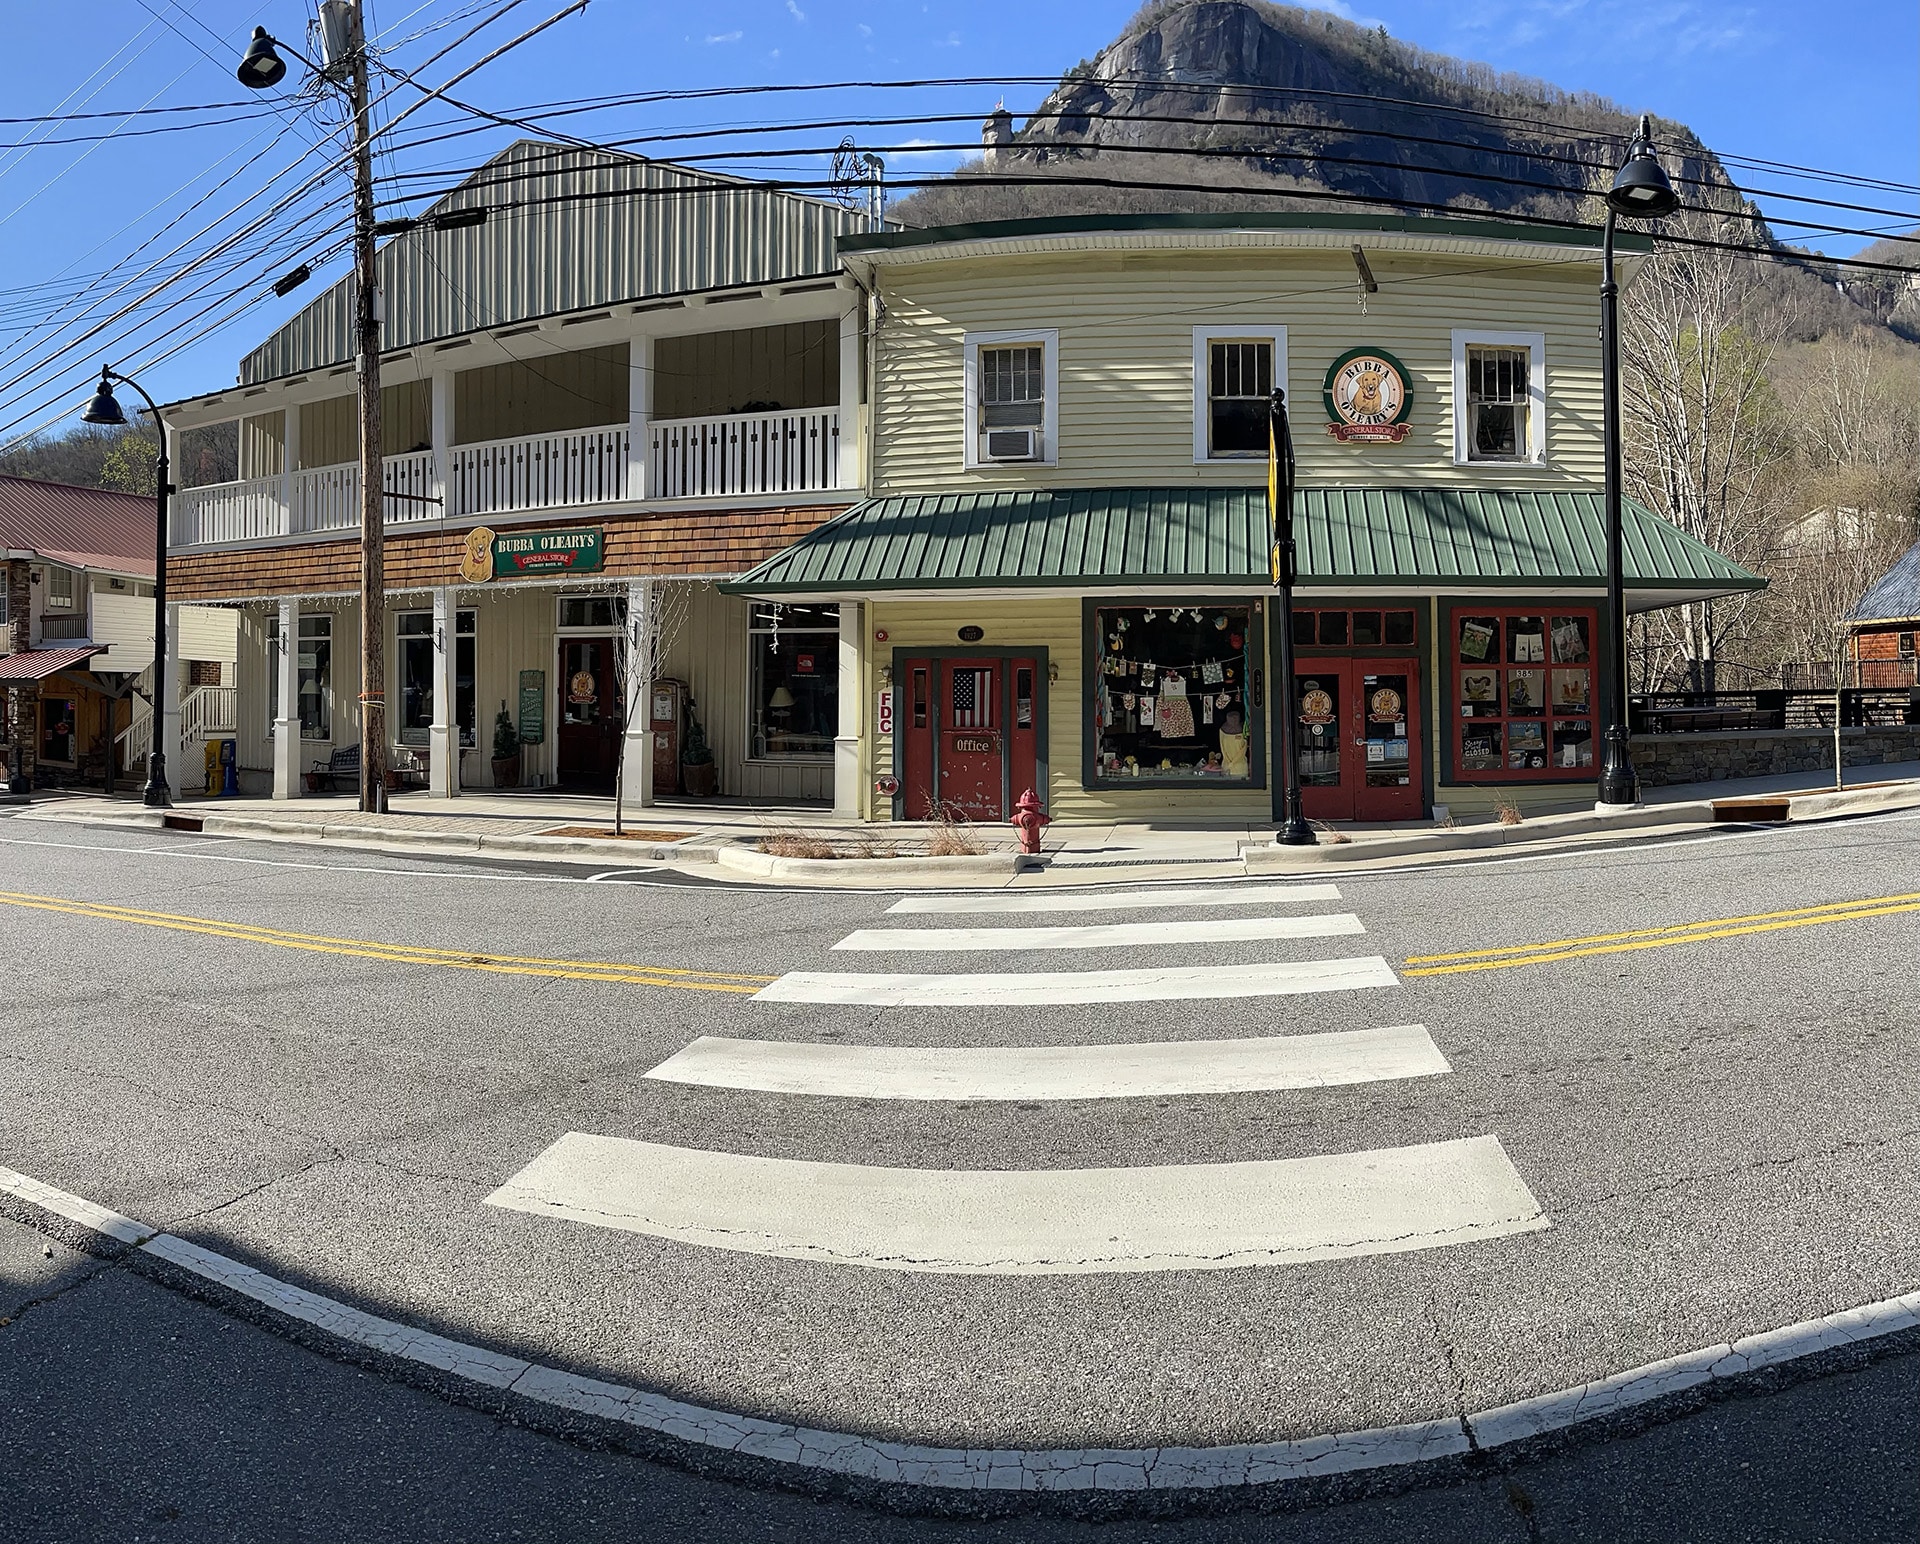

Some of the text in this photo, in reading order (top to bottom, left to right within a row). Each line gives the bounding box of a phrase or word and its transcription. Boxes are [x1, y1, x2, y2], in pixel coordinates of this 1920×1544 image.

[1345, 362, 1389, 378] BUBBA
[1341, 401, 1397, 425] O'LEARY'S
[1343, 426, 1396, 435] GENERAL STORE
[498, 535, 594, 553] BUBBA O'LEARY'S
[522, 554, 569, 564] GENERAL STORE
[1516, 670, 1533, 678] 385
[880, 693, 892, 732] FDC
[957, 739, 989, 751] Office
[1464, 740, 1483, 750] Sorry
[1464, 748, 1490, 757] CLOSED
